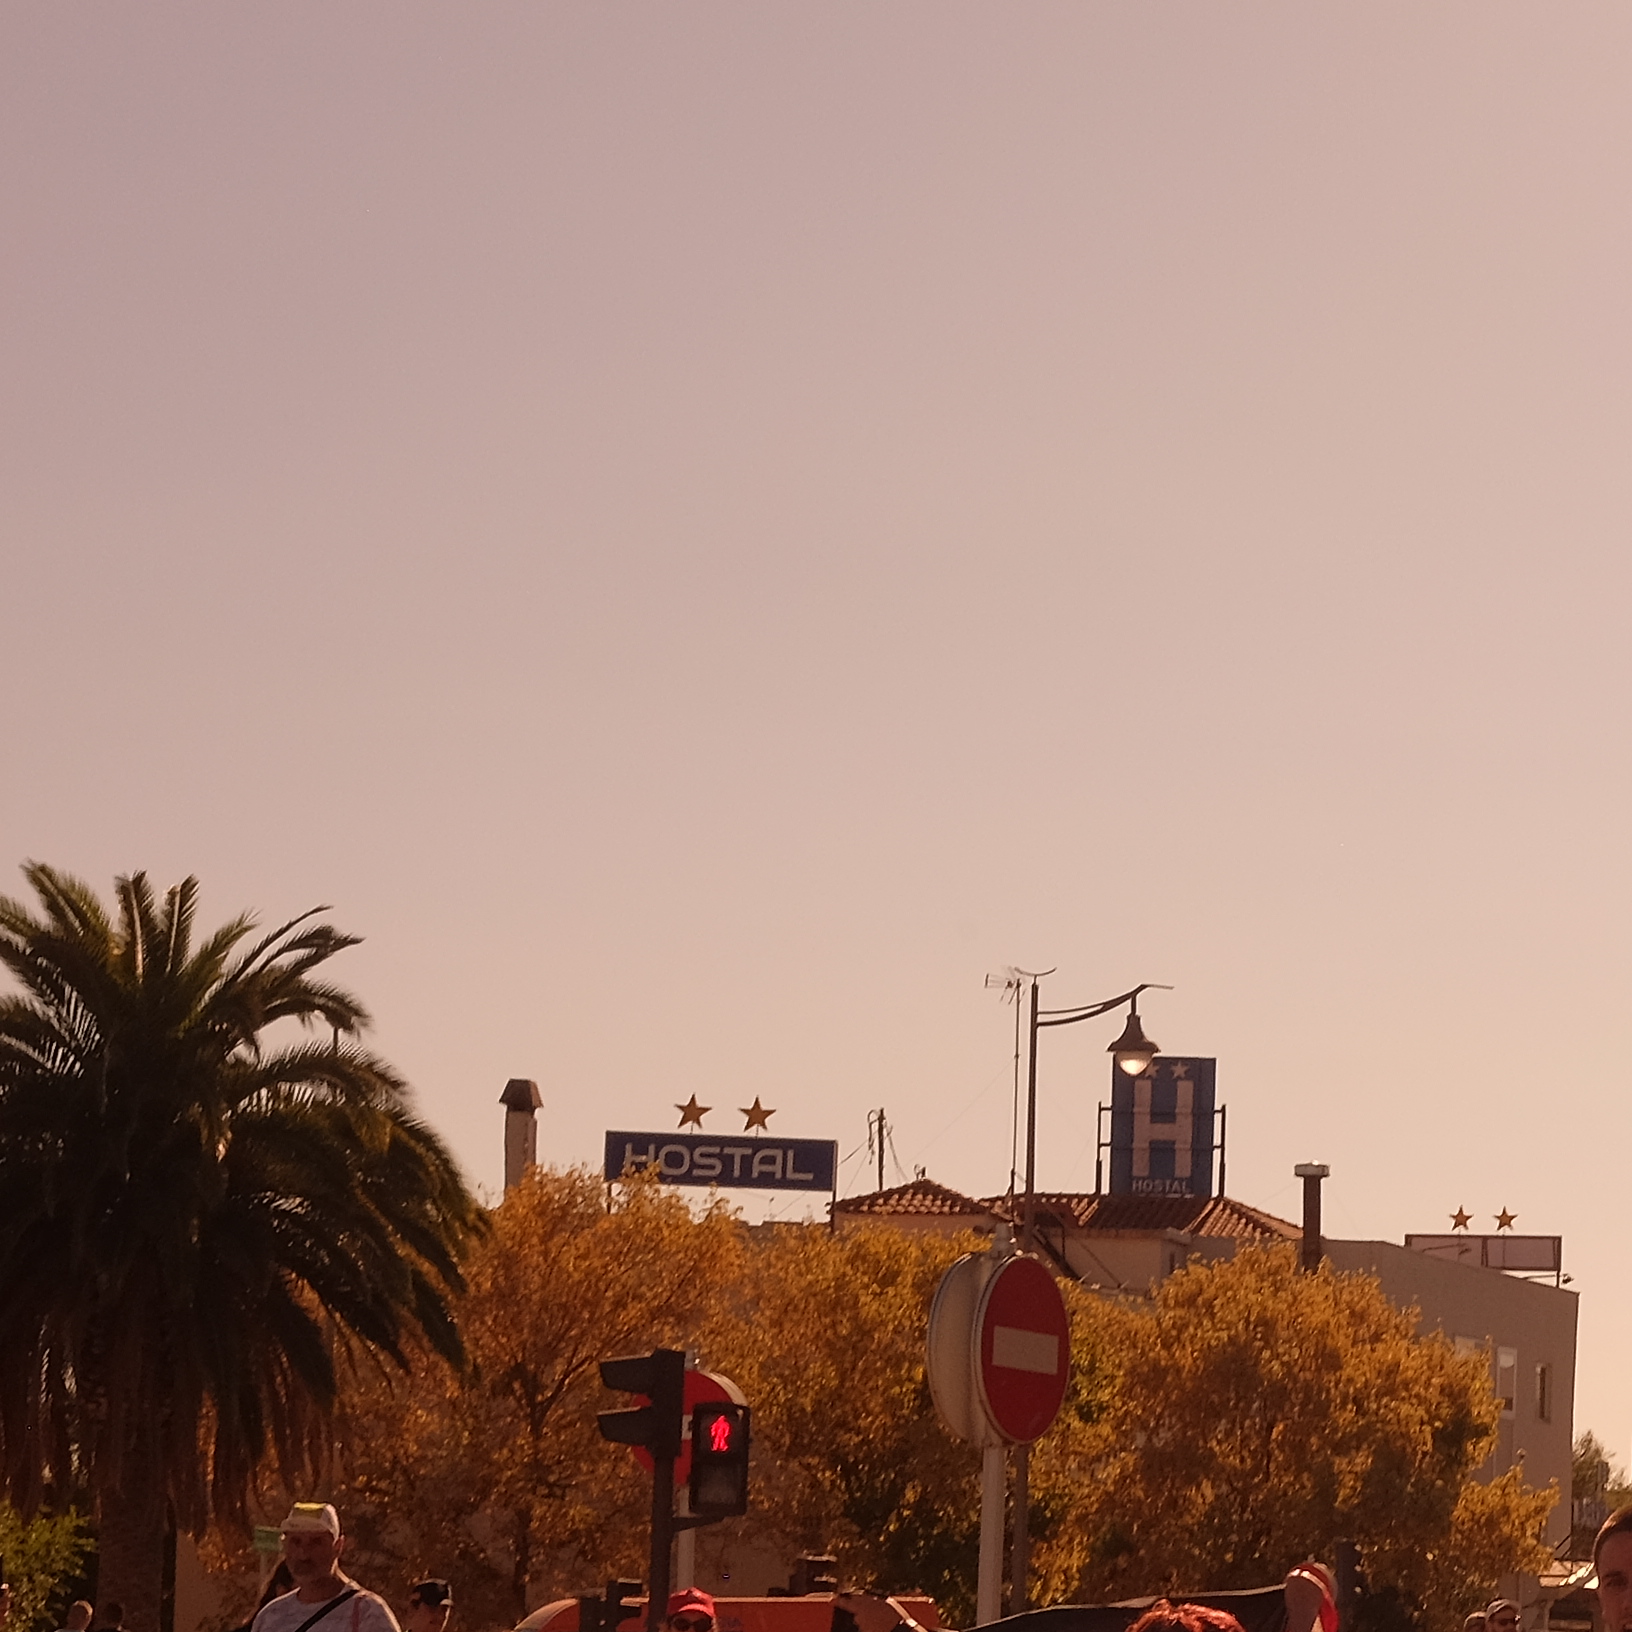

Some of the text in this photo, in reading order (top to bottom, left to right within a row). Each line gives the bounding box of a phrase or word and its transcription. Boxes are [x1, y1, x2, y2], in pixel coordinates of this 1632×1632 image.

[1132, 1079, 1194, 1178] H
[625, 1142, 814, 1181] HOSTAL
[1132, 1179, 1192, 1194] HOSTAL
